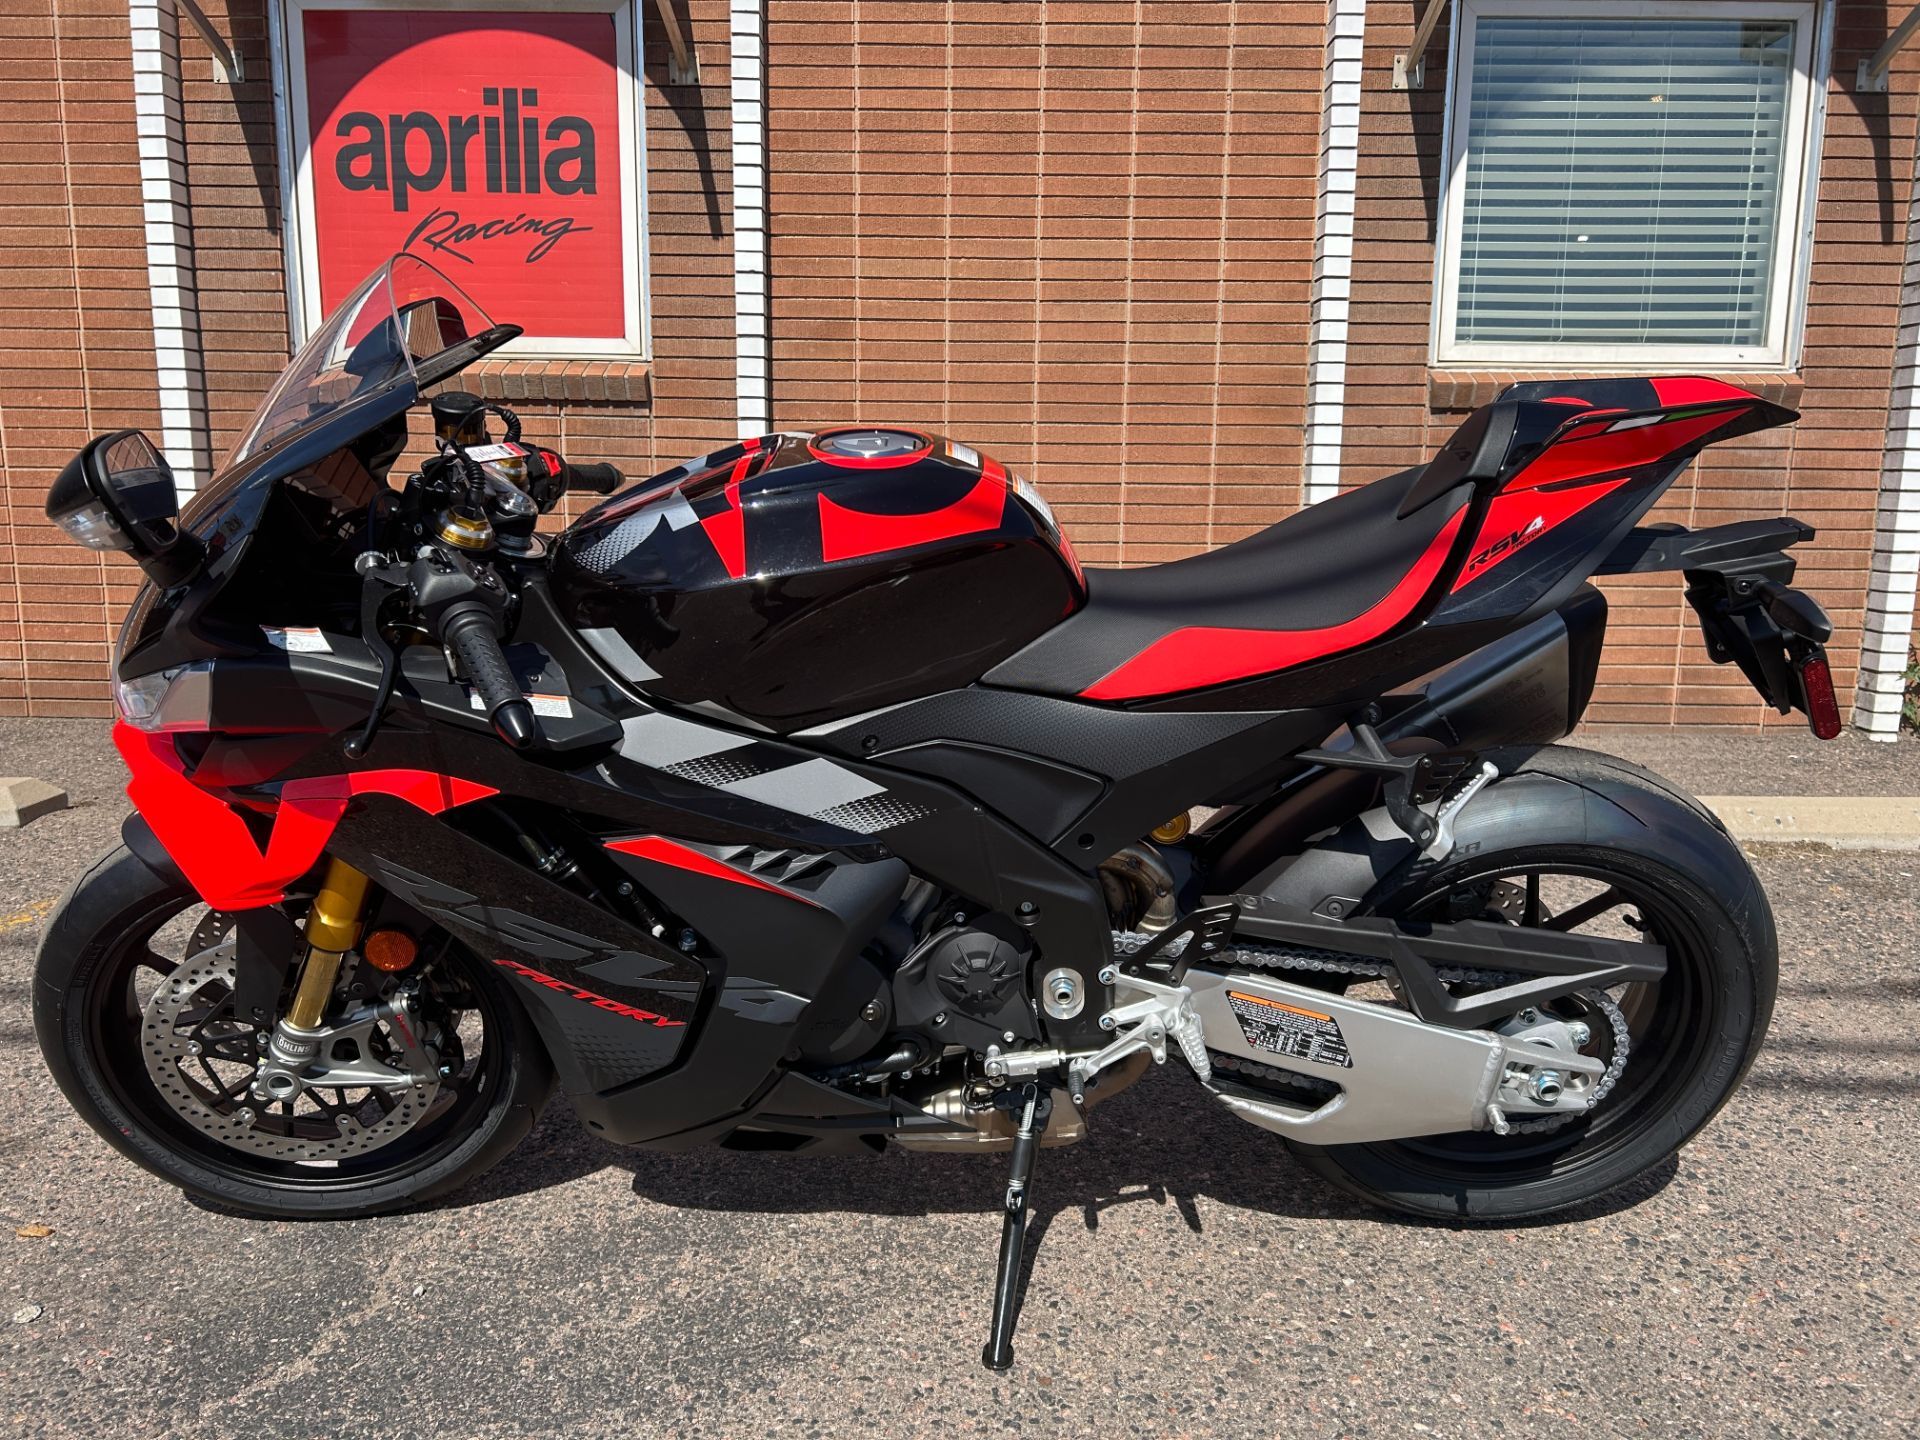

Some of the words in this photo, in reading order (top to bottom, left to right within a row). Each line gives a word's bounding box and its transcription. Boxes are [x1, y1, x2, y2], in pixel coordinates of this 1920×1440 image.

[335, 87, 598, 212] aprilia
[403, 207, 593, 264] Racing
[1468, 515, 1545, 572] RSV4
[492, 958, 688, 1028] FACTORY
